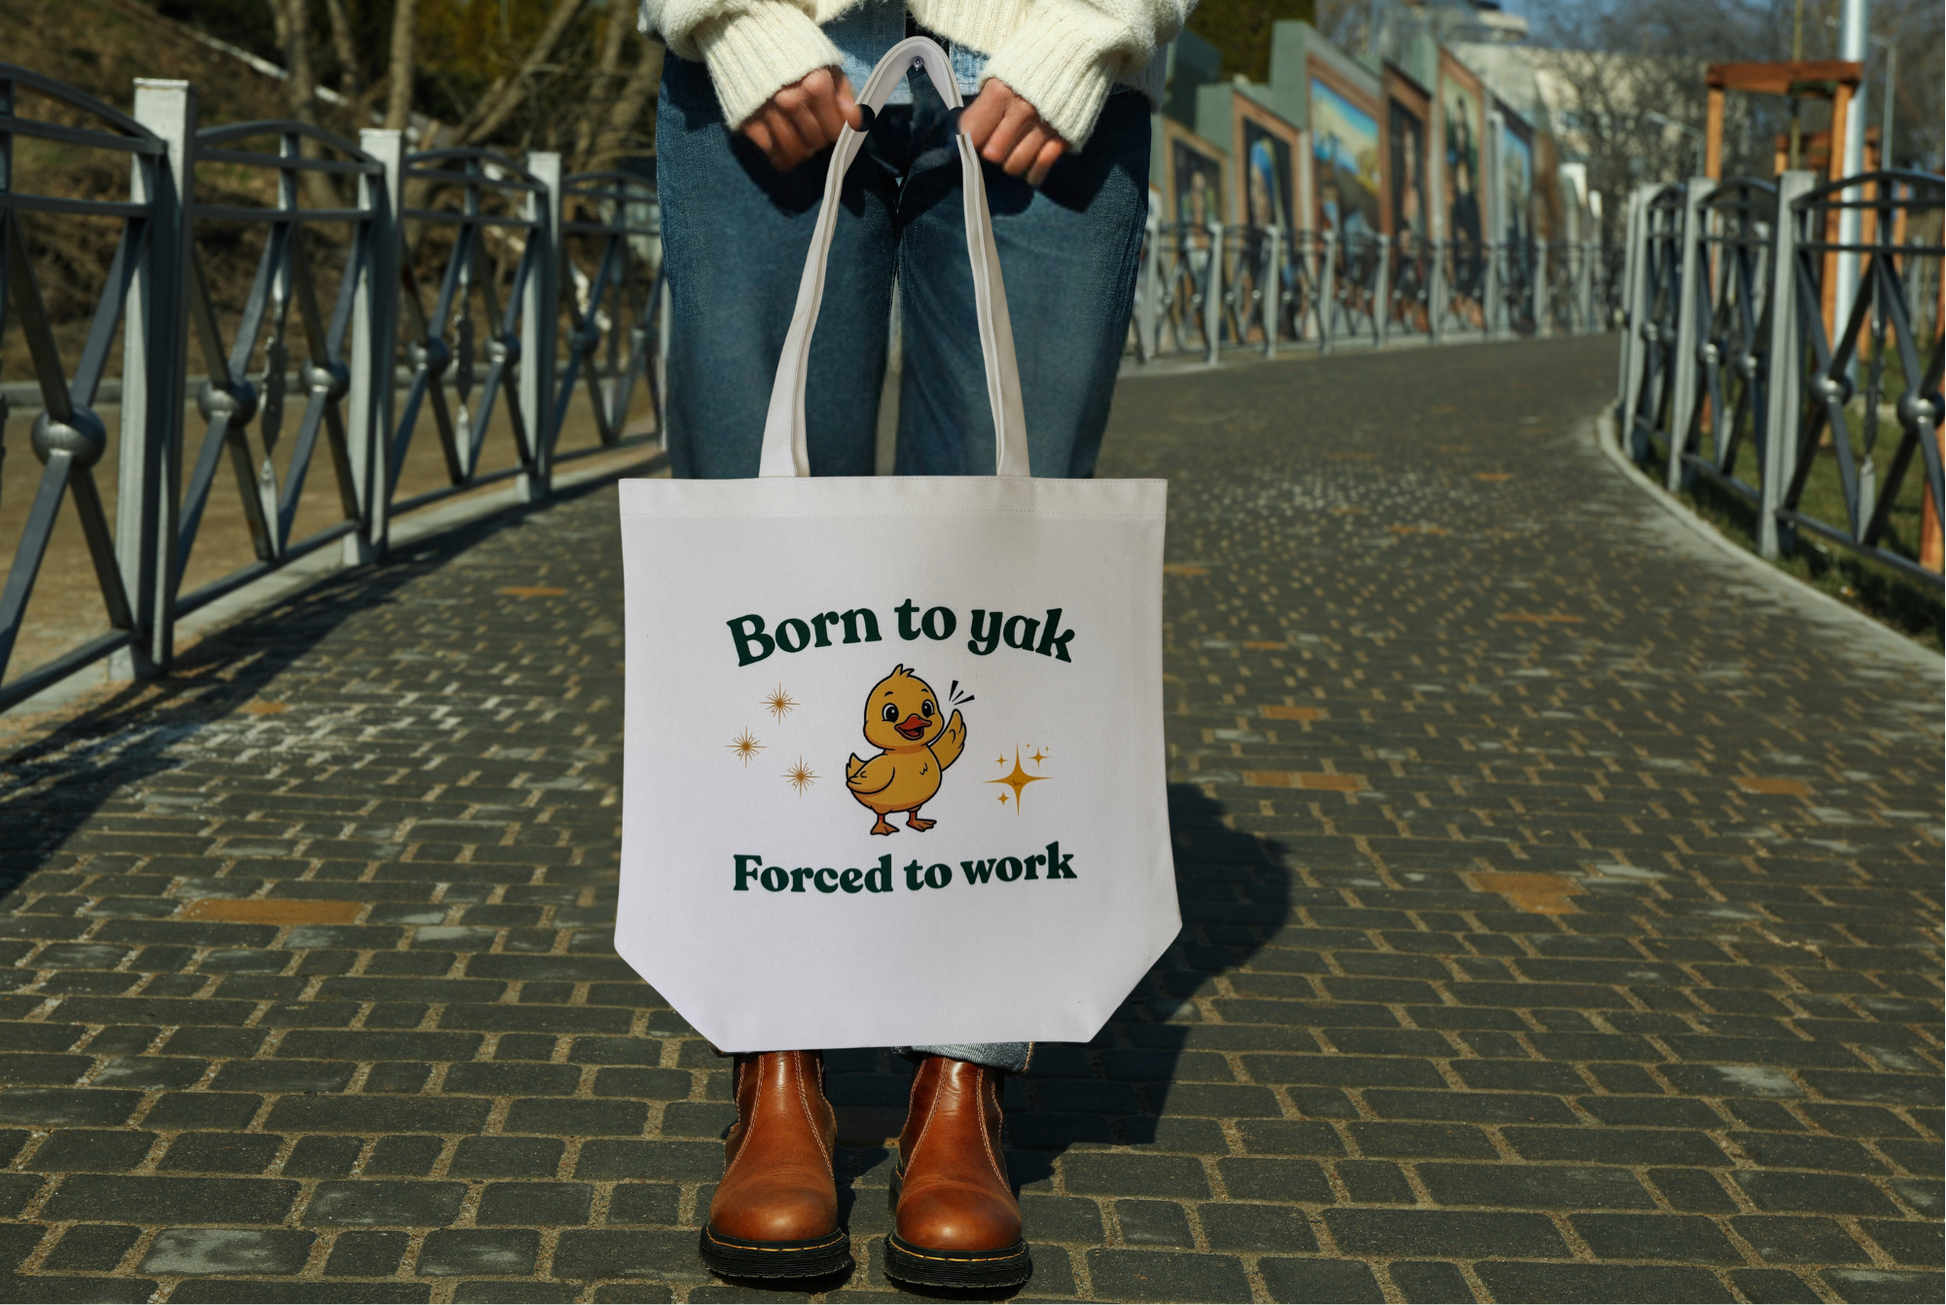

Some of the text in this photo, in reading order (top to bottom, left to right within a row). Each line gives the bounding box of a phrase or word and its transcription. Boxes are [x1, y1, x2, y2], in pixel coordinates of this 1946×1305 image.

[726, 598, 1076, 668] Born to yak
[733, 840, 1078, 894] Forced to work
